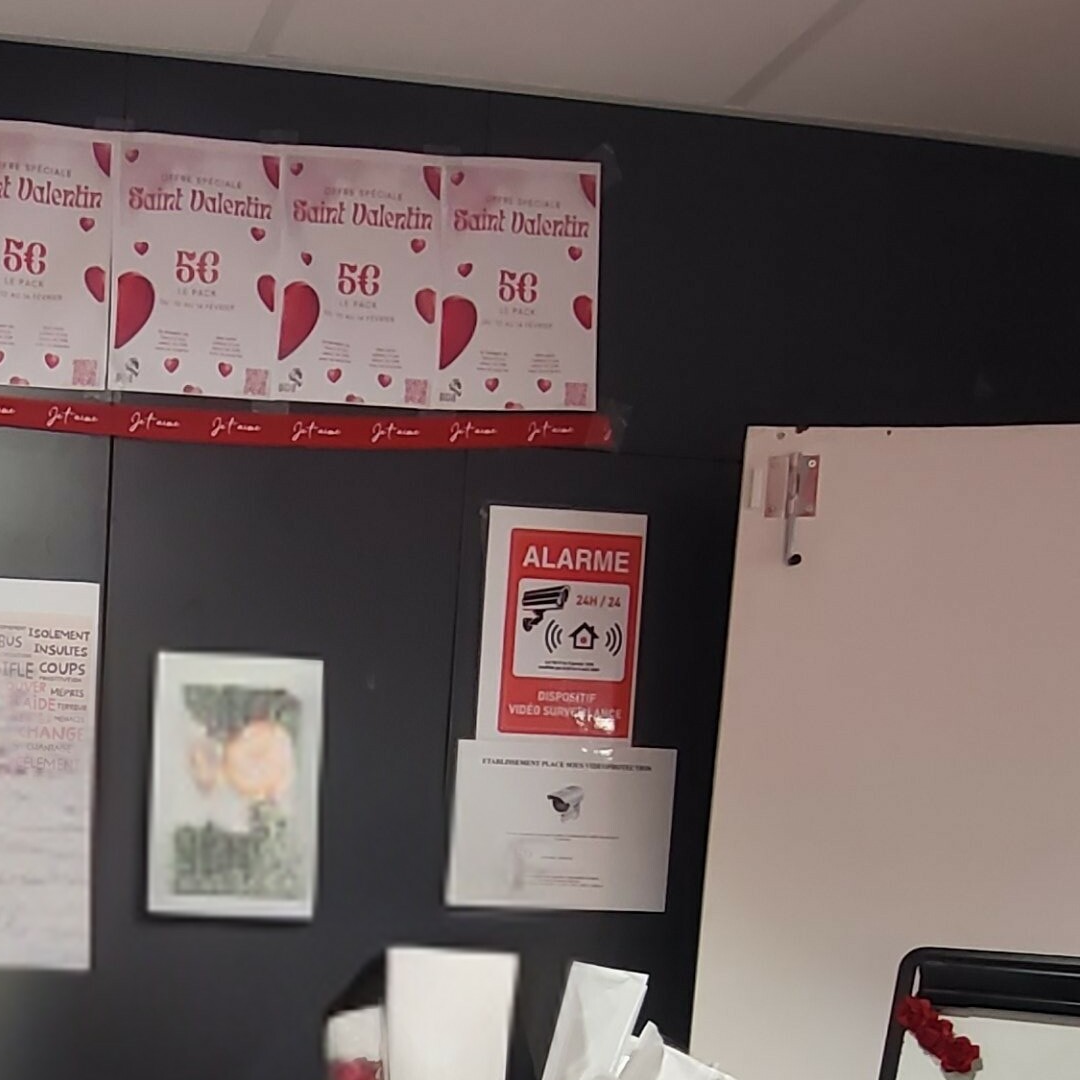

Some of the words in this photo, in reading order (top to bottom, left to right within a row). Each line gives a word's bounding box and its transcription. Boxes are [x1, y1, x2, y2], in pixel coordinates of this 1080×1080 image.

[18, 178, 102, 209] Valentin
[128, 186, 184, 211] Saint
[190, 190, 273, 221] Valentin
[292, 200, 345, 225] Saint
[352, 202, 433, 231] Valentin
[453, 208, 506, 233] Saint
[511, 210, 590, 239] Valentin
[3, 238, 47, 275] 5€
[176, 250, 220, 284] 5€
[338, 263, 381, 297] 5€
[498, 269, 538, 304] 5€
[522, 545, 630, 573] ALARME
[576, 595, 598, 607] 24H
[608, 596, 621, 608] 24
[28, 628, 90, 641] ISOLEMENT
[34, 643, 88, 657] INSULTES
[39, 662, 85, 676] COUPS
[509, 703, 540, 715] VIDÉO
[538, 691, 597, 702] DISPOSITIF
